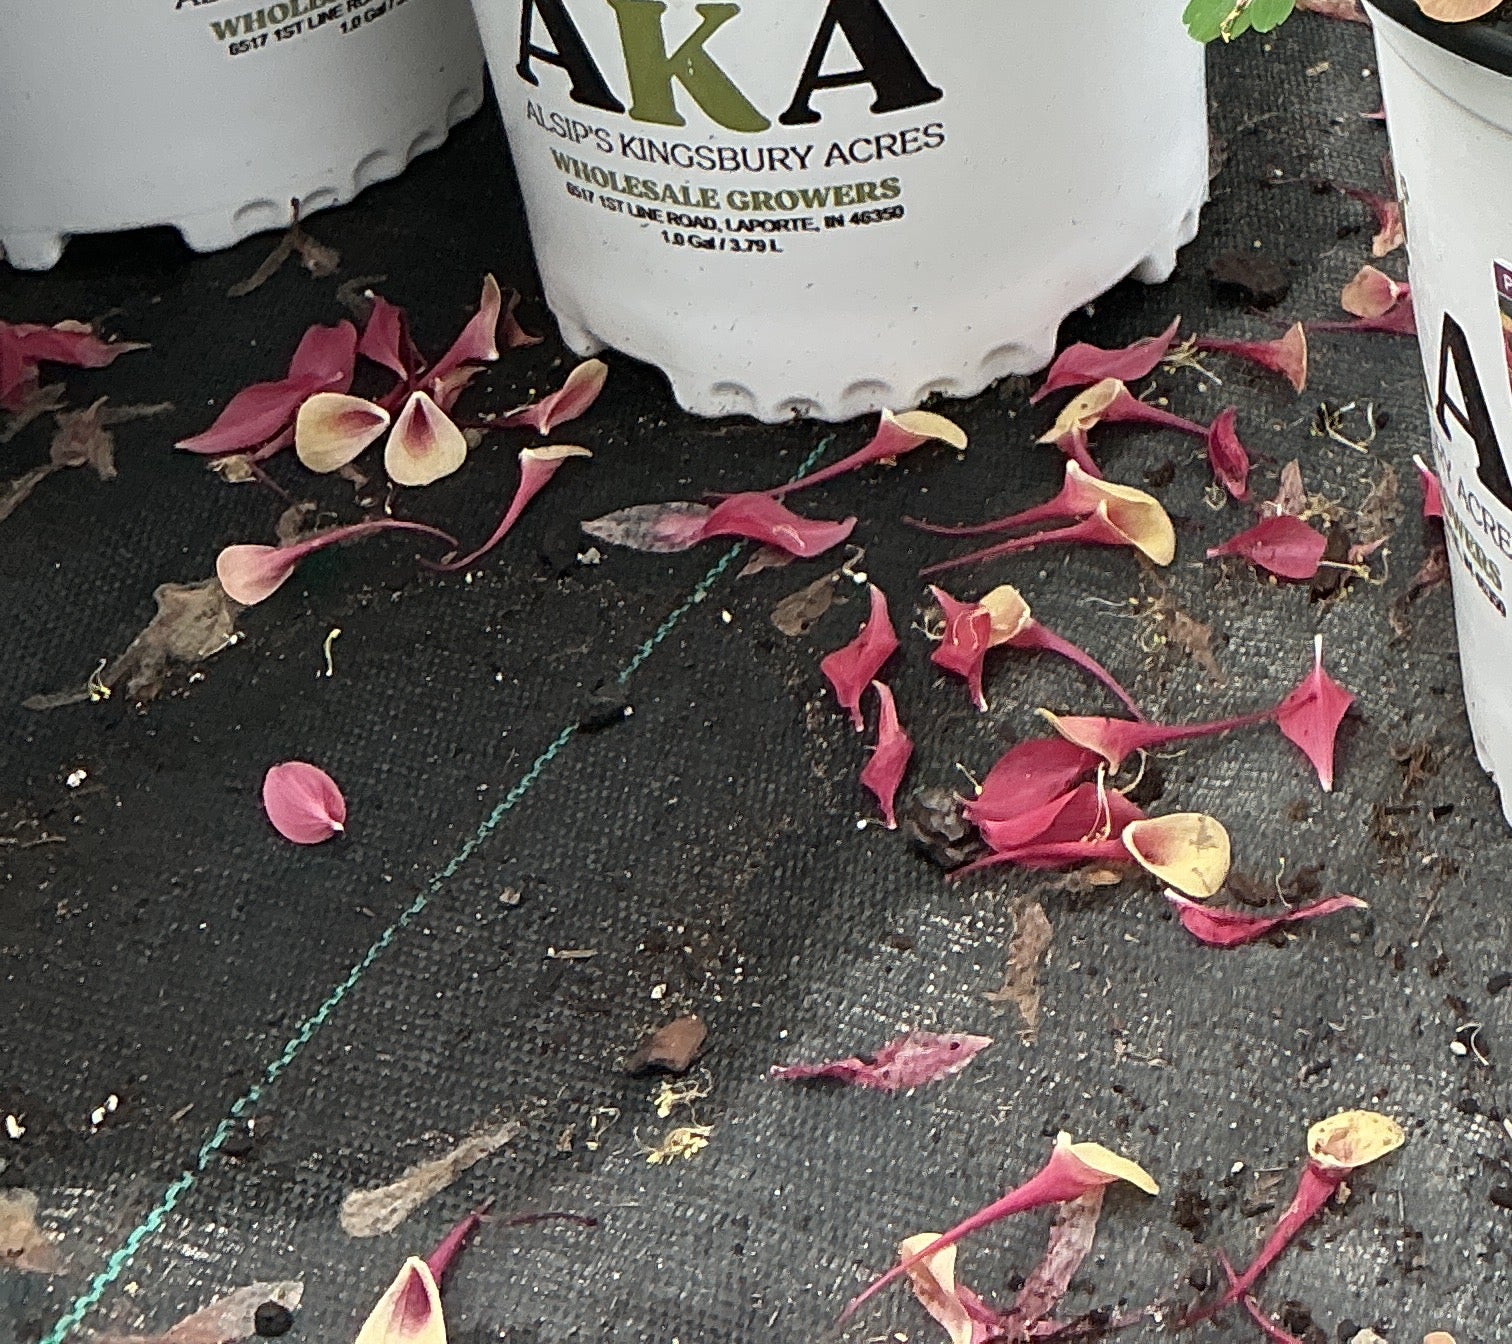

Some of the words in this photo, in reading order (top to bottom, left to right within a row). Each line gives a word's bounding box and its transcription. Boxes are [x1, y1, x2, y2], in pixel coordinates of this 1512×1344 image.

[275, 19, 303, 42] 1ST
[307, 4, 343, 29] LINE
[364, 1, 388, 24] Gal
[526, 100, 614, 154] ALSIP'S
[619, 132, 813, 173] KINGSBURY
[825, 122, 946, 169] ACRES
[550, 147, 720, 210] WHOLESALE
[727, 176, 901, 212] GROWERS
[599, 193, 625, 214] 1ST
[628, 204, 664, 226] LINE
[665, 210, 722, 233] ROAD,
[725, 215, 821, 233] LAPORTE,
[824, 214, 845, 229] IN
[687, 233, 715, 252] Gal
[728, 237, 767, 254] 3.79
[768, 237, 784, 253] L
